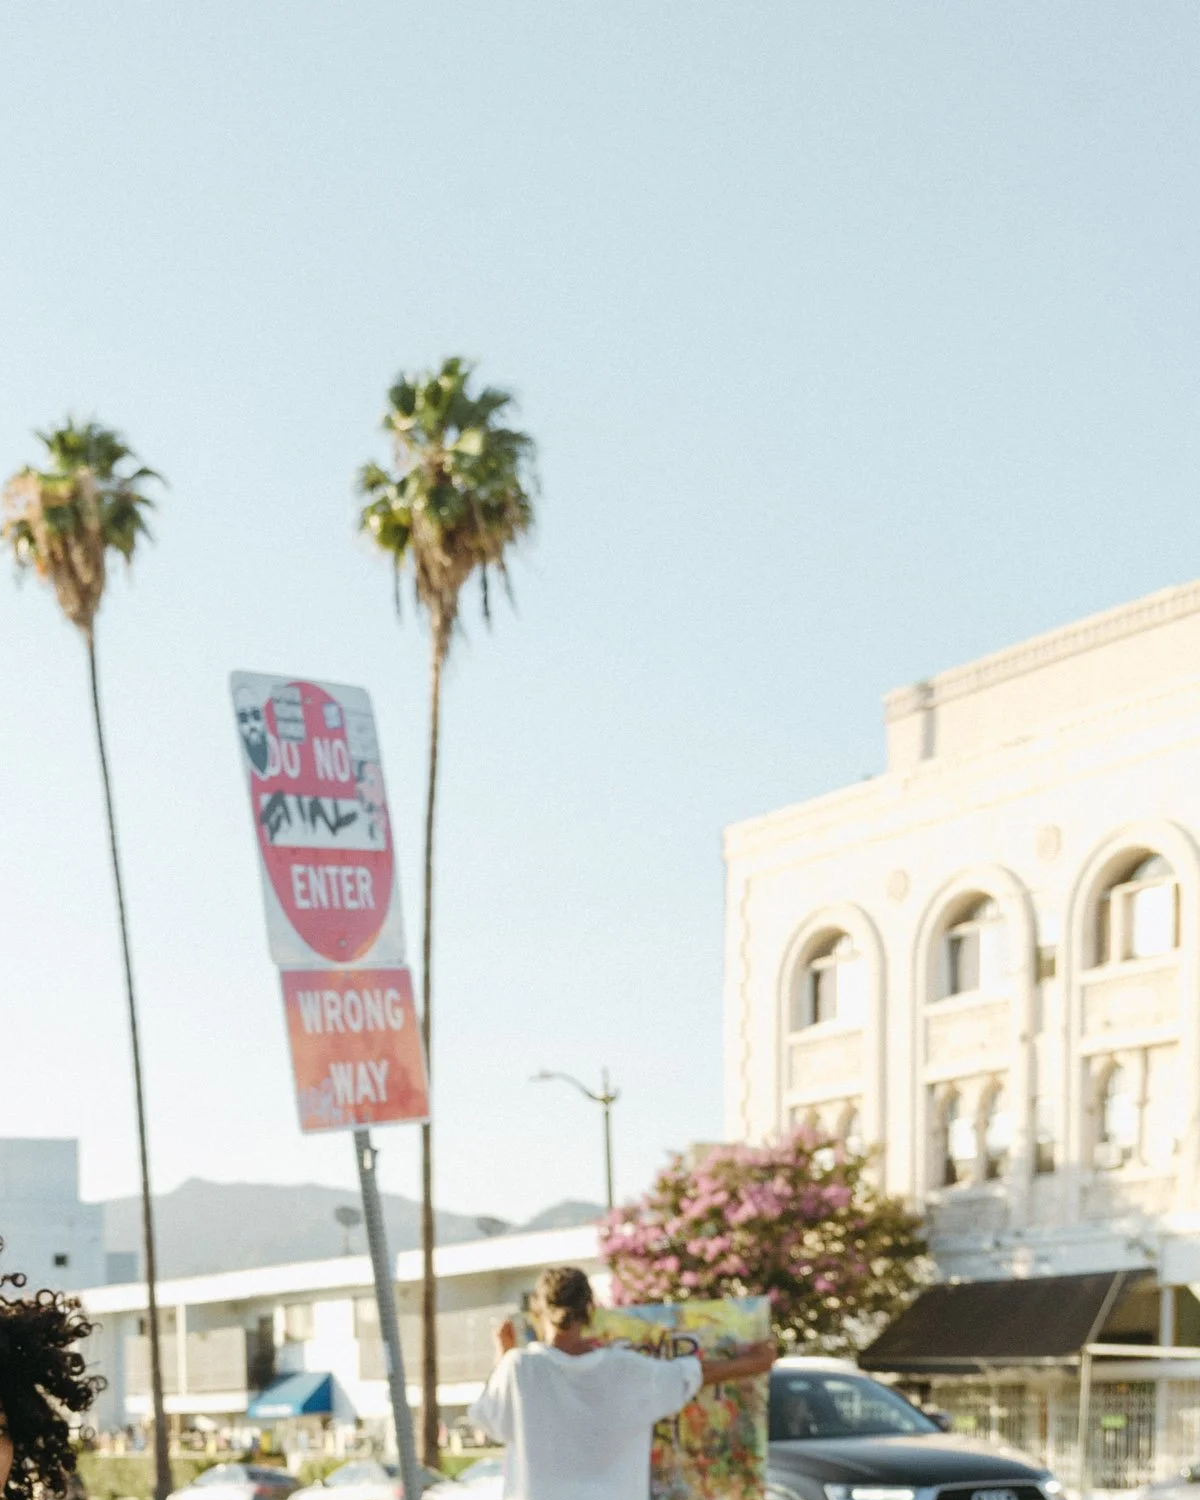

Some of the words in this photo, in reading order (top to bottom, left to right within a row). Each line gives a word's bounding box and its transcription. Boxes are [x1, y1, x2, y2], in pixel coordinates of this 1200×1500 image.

[291, 863, 376, 910] ENTER
[297, 987, 405, 1034] WRONG
[329, 1059, 389, 1106] WAY
